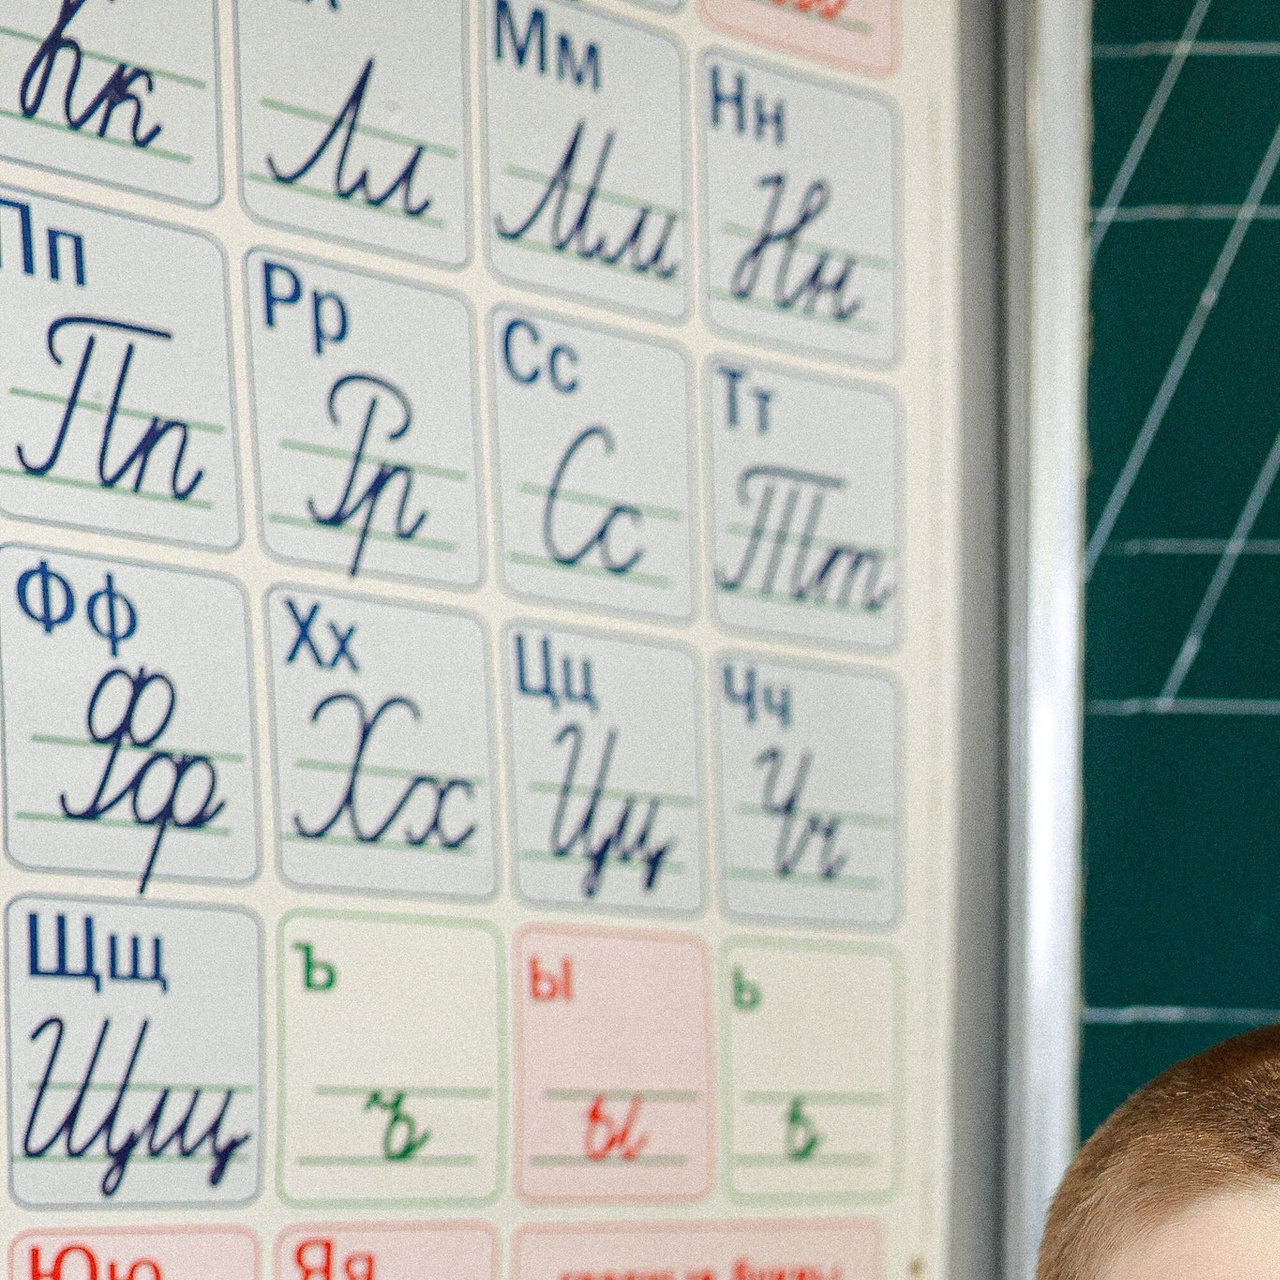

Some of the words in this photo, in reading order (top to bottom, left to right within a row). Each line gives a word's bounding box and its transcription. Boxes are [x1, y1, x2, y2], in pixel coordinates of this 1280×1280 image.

[495, 0, 600, 92] Мм
[709, 64, 786, 145] Нн
[263, 260, 348, 356] Рр
[504, 318, 579, 394] Сс
[718, 365, 775, 434] Тт
[17, 316, 203, 500] Пп
[307, 373, 428, 577] Рр
[544, 426, 645, 575] Сс
[16, 558, 138, 658] Фф
[284, 598, 359, 673] Хх
[515, 633, 599, 712] Цц
[724, 664, 793, 728] Чч
[59, 667, 225, 895] Фф
[293, 693, 476, 849] Хх
[29, 913, 168, 994] Щщ
[23, 1016, 251, 1196] Щщ
